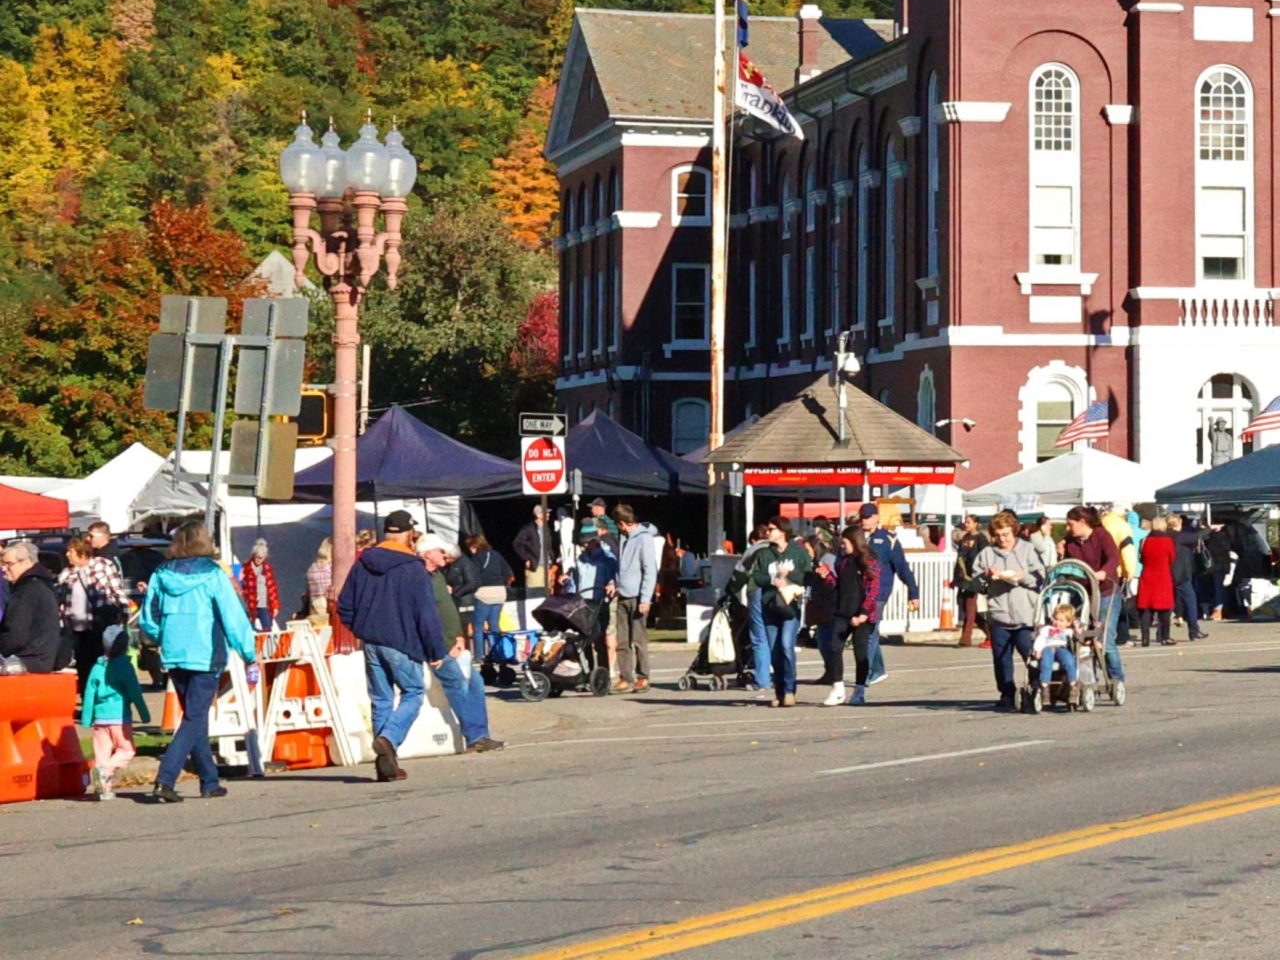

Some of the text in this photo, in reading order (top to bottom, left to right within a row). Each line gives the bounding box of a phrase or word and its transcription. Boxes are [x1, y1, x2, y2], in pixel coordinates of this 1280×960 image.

[525, 420, 553, 429] ONE WAY
[528, 448, 558, 458] DO NOT
[532, 472, 556, 483] ENTER
